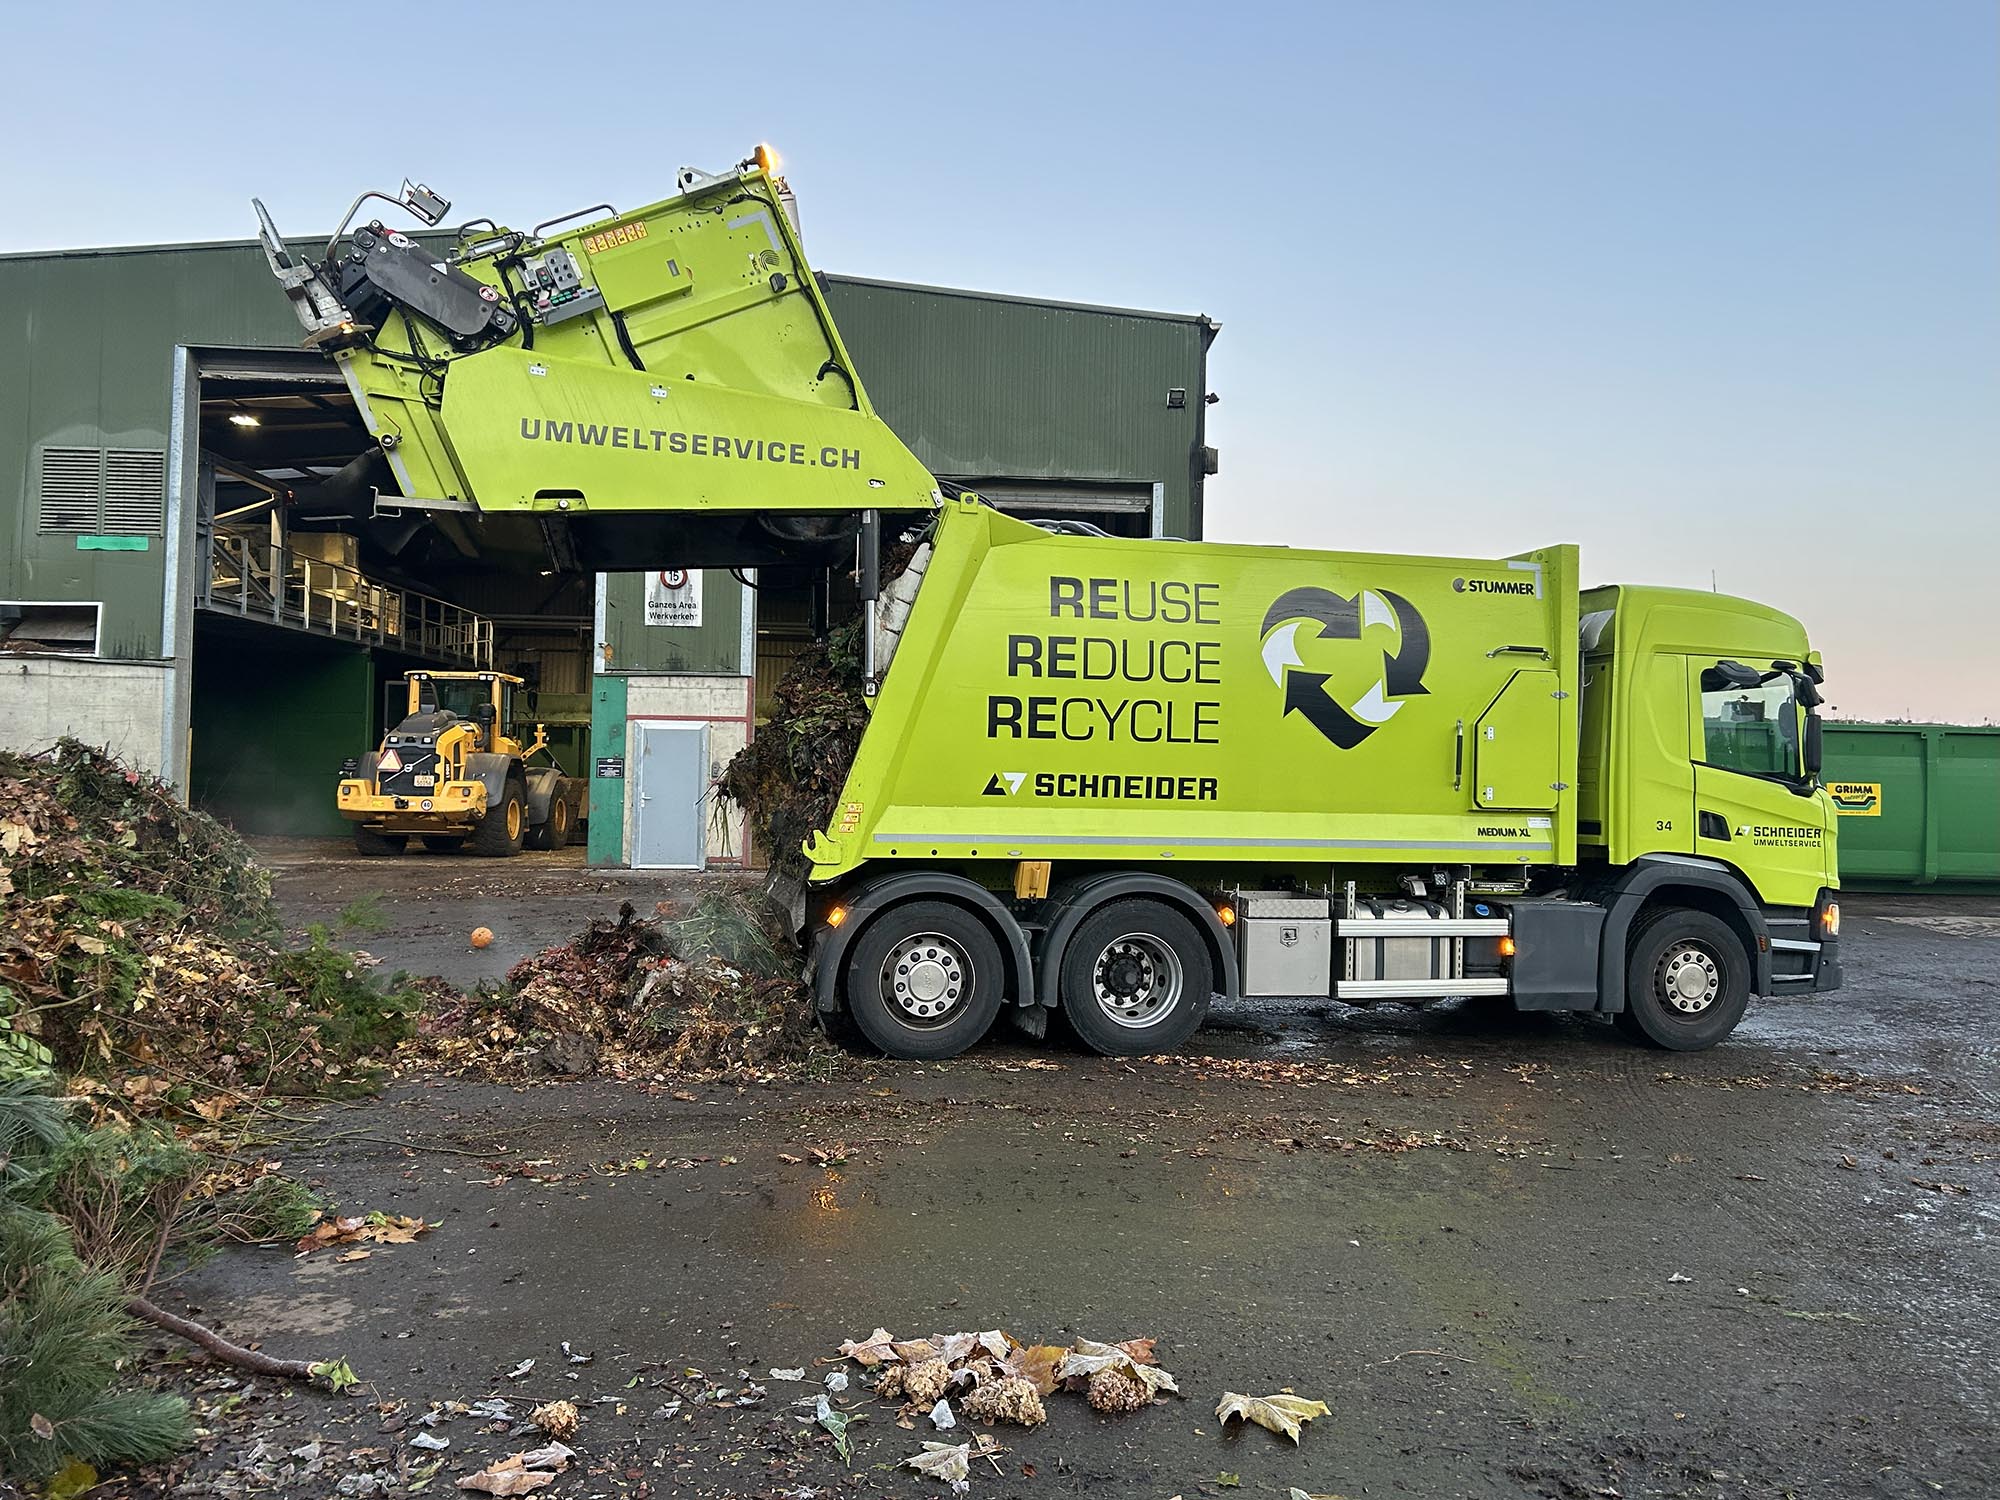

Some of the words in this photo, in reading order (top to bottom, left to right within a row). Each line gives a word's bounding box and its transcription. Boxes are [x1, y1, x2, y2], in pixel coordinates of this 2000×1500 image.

[521, 418, 860, 470] UMWELTSERVICE.CH
[669, 570, 679, 581] 15
[1469, 580, 1534, 595] STUMMER
[648, 600, 677, 609] Ganzes
[678, 601, 697, 609] Area
[1050, 576, 1220, 624] REUSE
[1008, 634, 1220, 684] REDUCE
[987, 695, 1220, 744] RECYCLE
[1035, 773, 1218, 801] SCHNEIDER
[1835, 785, 1873, 794] GRIMM
[1477, 827, 1517, 836] MEDIUM
[1519, 828, 1531, 837] XL
[1656, 821, 1672, 831] 34
[1753, 826, 1822, 839] SCHNEIDER
[1753, 839, 1822, 848] UMWELTSERVICE
